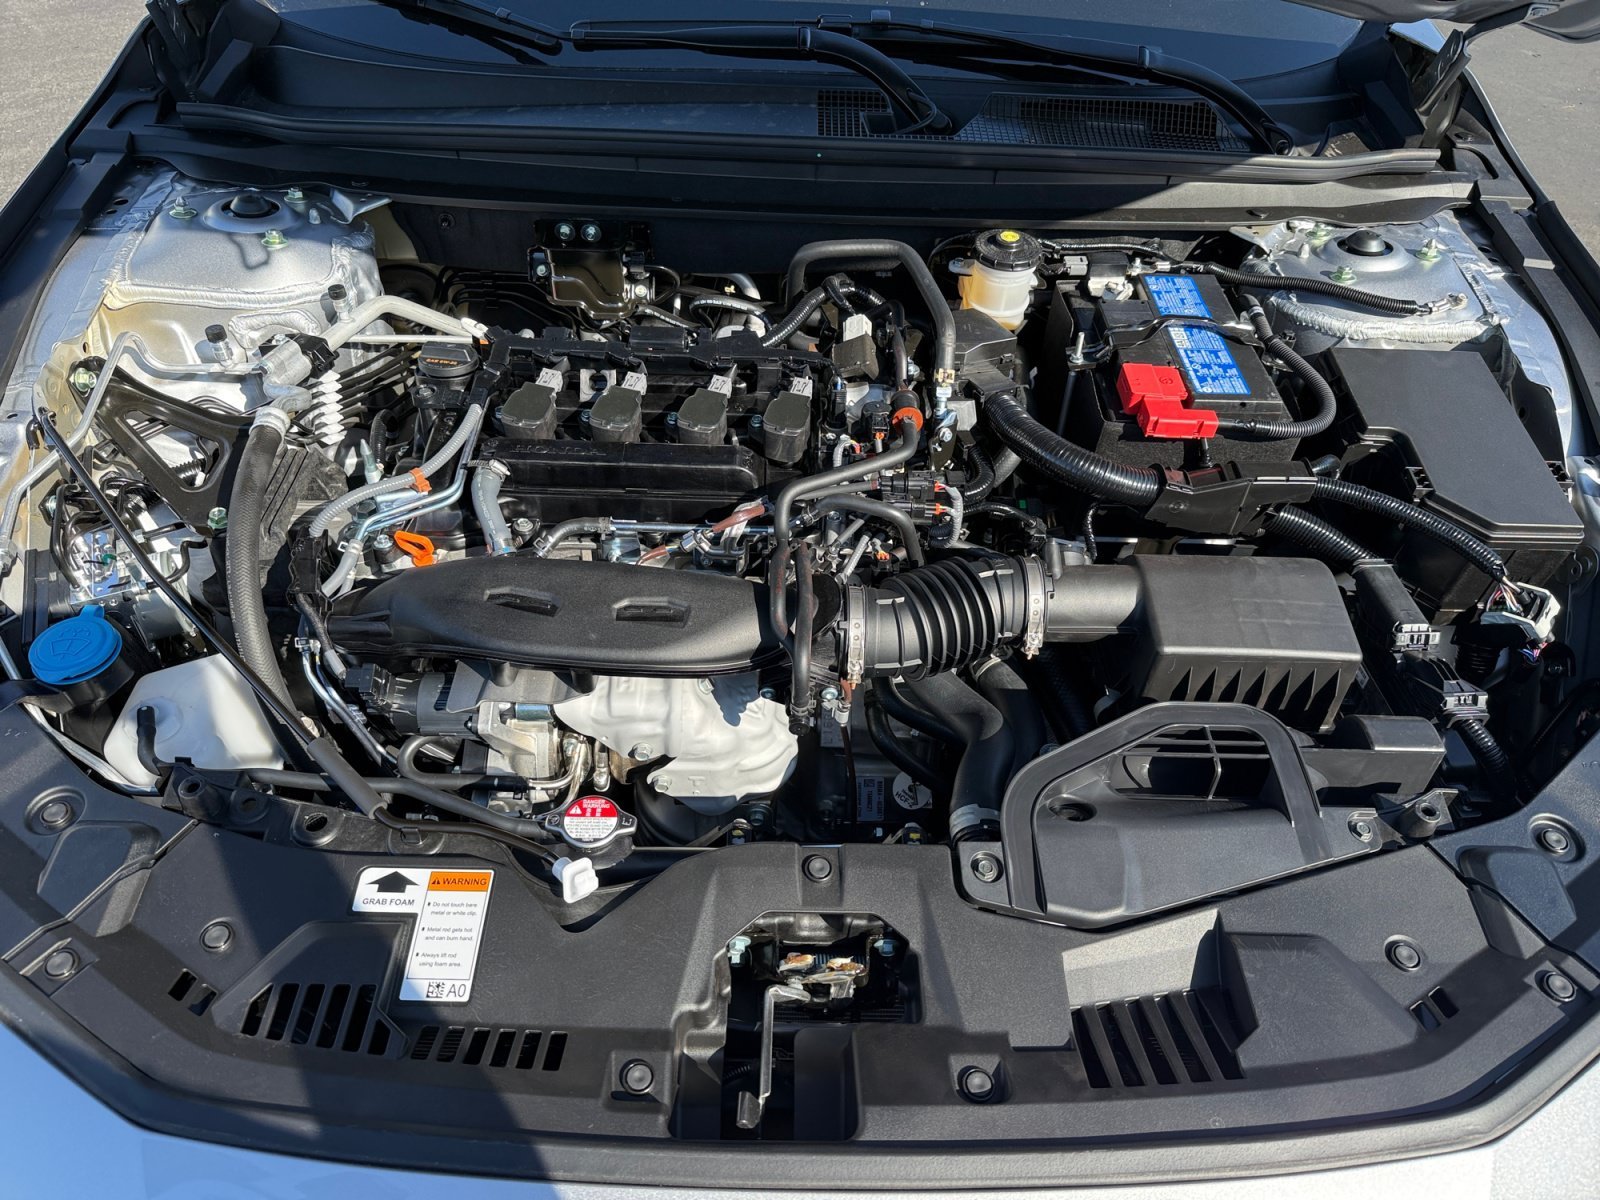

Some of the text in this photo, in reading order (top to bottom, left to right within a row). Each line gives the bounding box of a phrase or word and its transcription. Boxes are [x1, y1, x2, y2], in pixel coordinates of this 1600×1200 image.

[442, 878, 487, 886] WARNING
[362, 897, 415, 906] GRAB FOAM
[446, 983, 467, 998] A0
